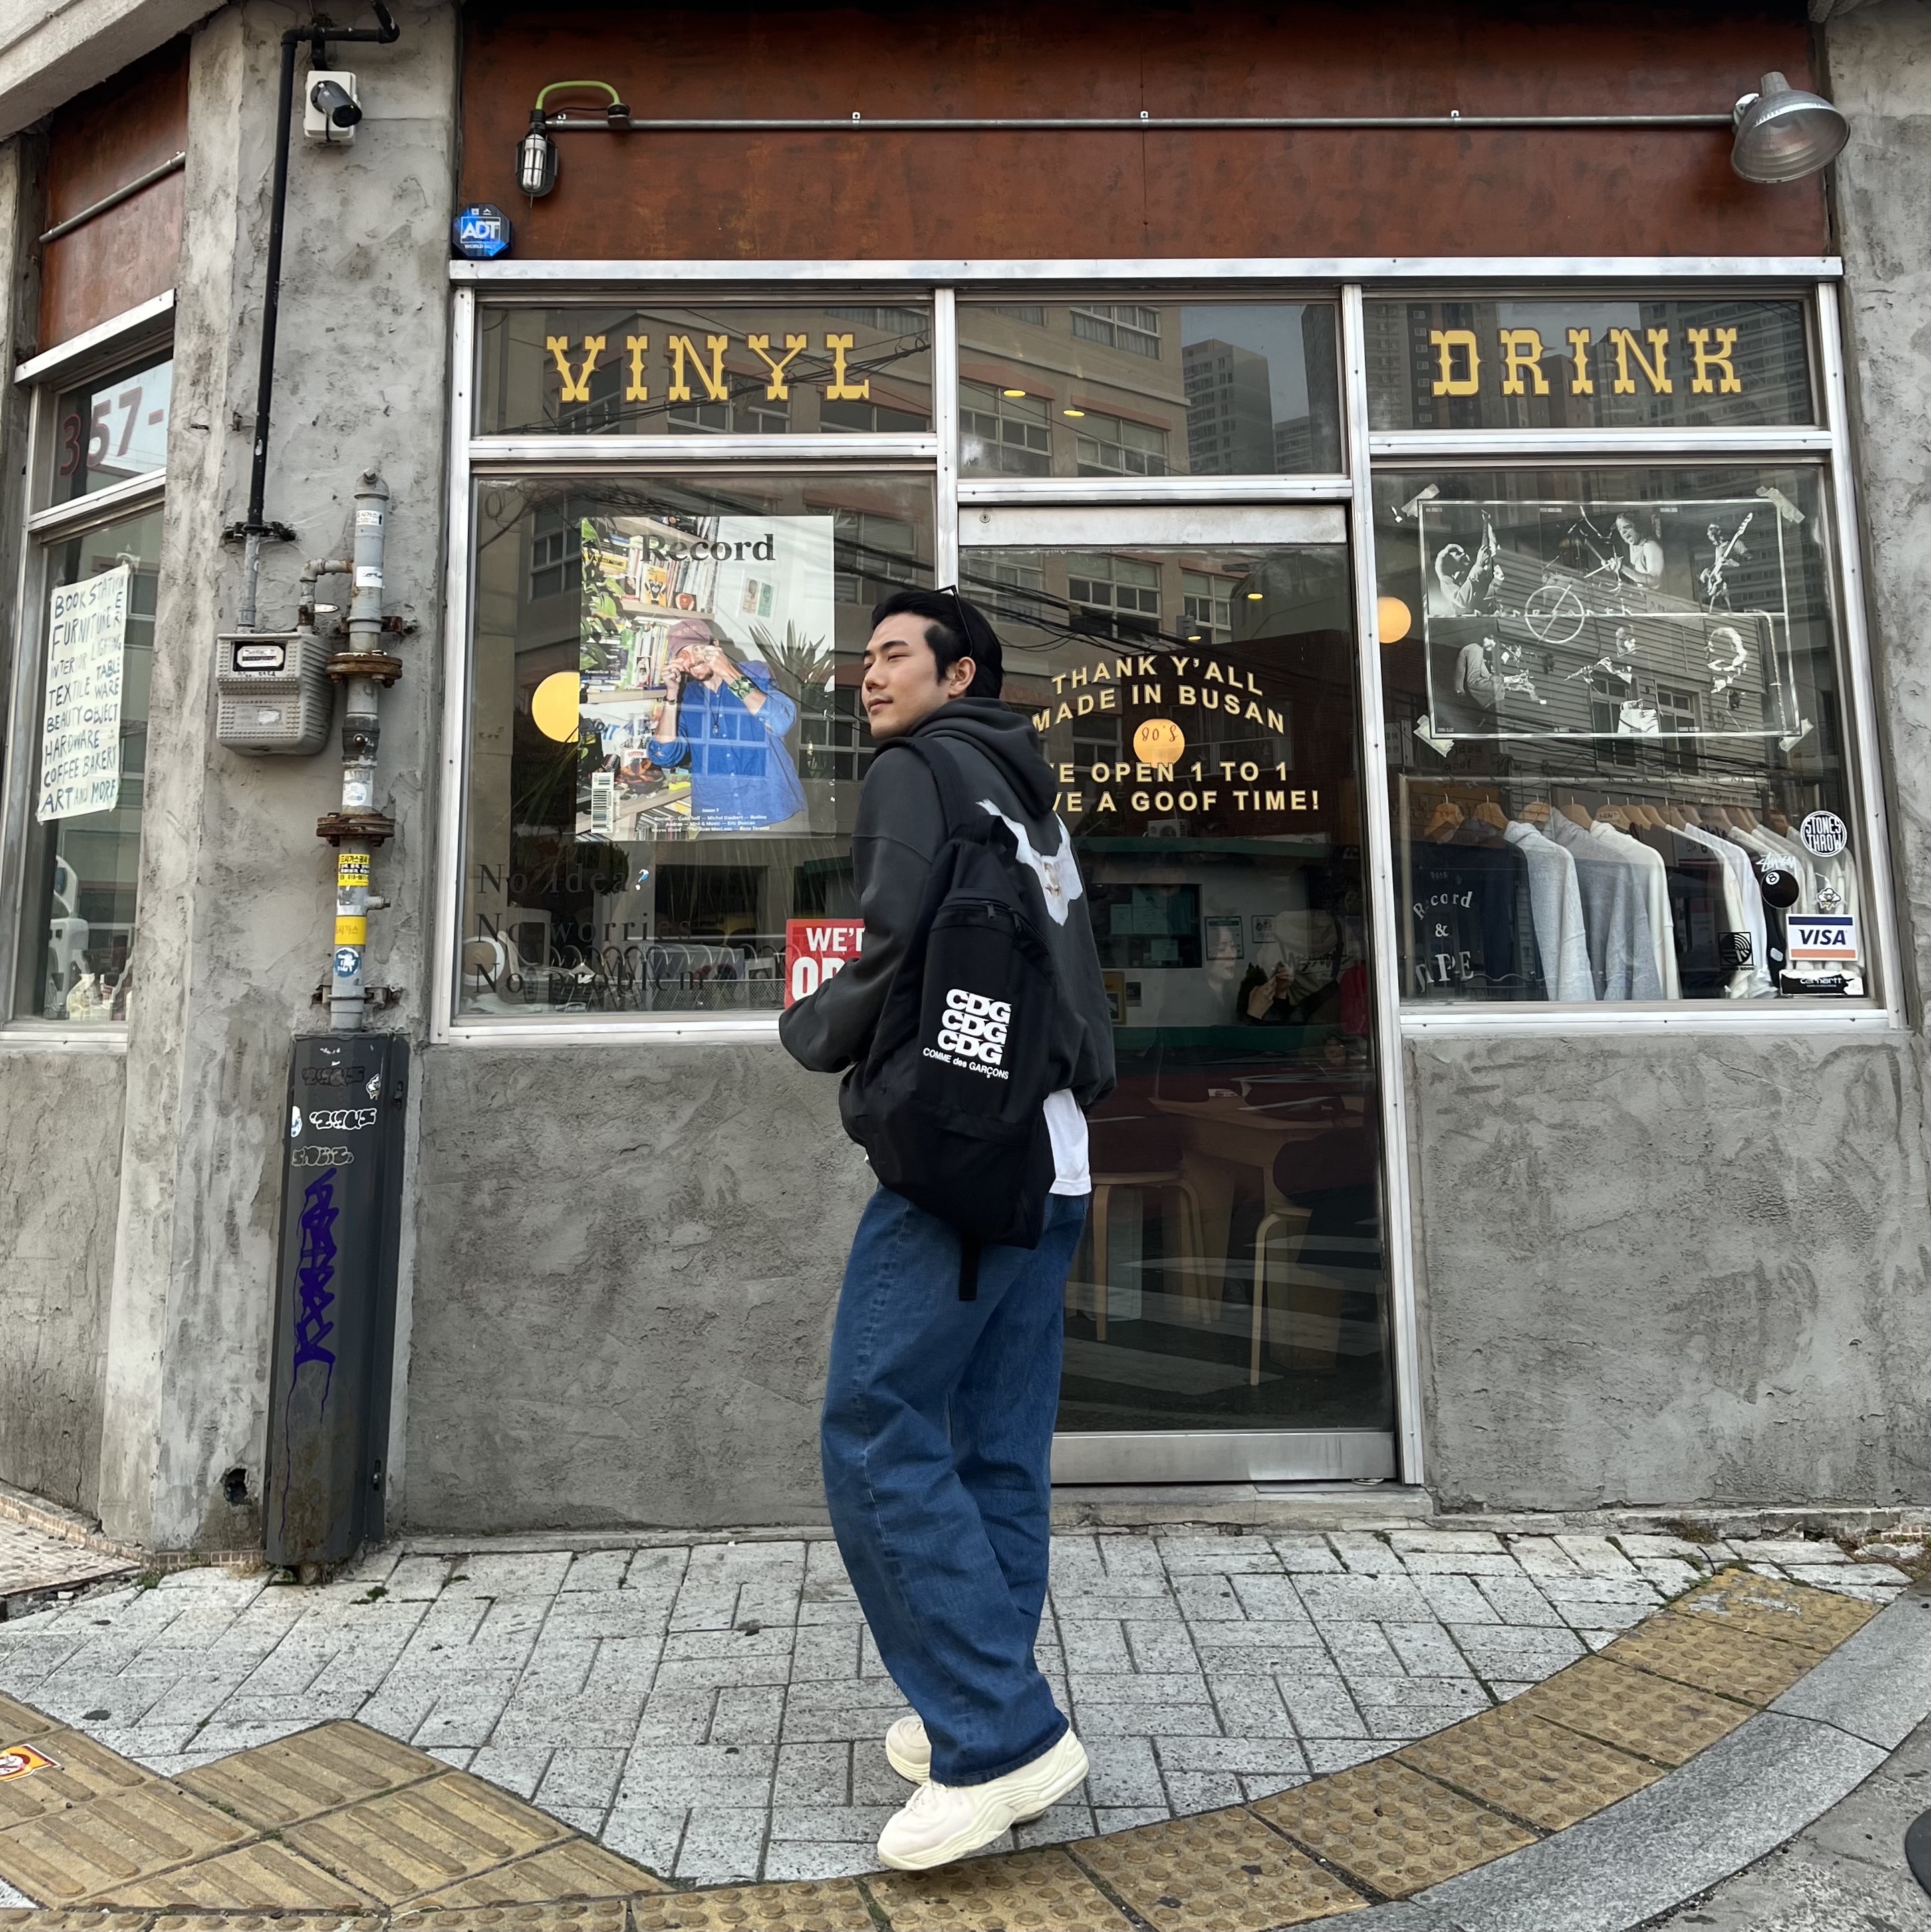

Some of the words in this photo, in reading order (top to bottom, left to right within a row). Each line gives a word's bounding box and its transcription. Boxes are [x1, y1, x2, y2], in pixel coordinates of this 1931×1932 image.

[461, 220, 500, 239] ADT
[545, 334, 871, 402] VINYL
[1428, 327, 1742, 397] DRINK
[641, 533, 776, 562] Record
[55, 590, 86, 619] BOOK
[96, 657, 120, 681] TABLE
[1051, 654, 1158, 695] THANK
[1169, 656, 1263, 697] Y'ALL
[49, 677, 90, 710] TEXTILE
[95, 677, 120, 699] WARE
[47, 705, 83, 733] BEAUTY
[84, 703, 118, 724] OBJECT
[1031, 688, 1116, 733] MADE
[1131, 684, 1162, 705] IN
[1178, 685, 1285, 735] BUSAN
[45, 729, 100, 765] HARDWARE
[44, 757, 79, 788] COFFEE
[82, 744, 116, 777] BAKERY
[1091, 762, 1174, 783] OPEN
[1190, 761, 1202, 782] 1
[1219, 761, 1259, 782] TO
[1275, 761, 1287, 781] 1
[41, 788, 74, 813] ART
[91, 779, 116, 804] MORE
[1096, 792, 1118, 812] A
[1130, 790, 1217, 812] GOOF
[1233, 790, 1319, 811] TIME!
[1805, 817, 1841, 834] STONES
[1807, 834, 1841, 852] THROW
[478, 864, 527, 894] No
[475, 913, 522, 943] No
[549, 913, 692, 943] worries
[805, 927, 865, 952] WE'
[1435, 923, 1449, 937] &
[1797, 929, 1846, 945] VISA
[473, 963, 523, 993] No
[548, 958, 704, 1001] problem
[792, 956, 846, 1001] OP
[946, 989, 1012, 1024] CDG
[942, 1009, 1009, 1044] CDG
[937, 1030, 1005, 1065] CDG
[923, 1048, 952, 1063] COMME
[953, 1058, 967, 1068] des
[969, 1062, 1009, 1080] GARÇONS
